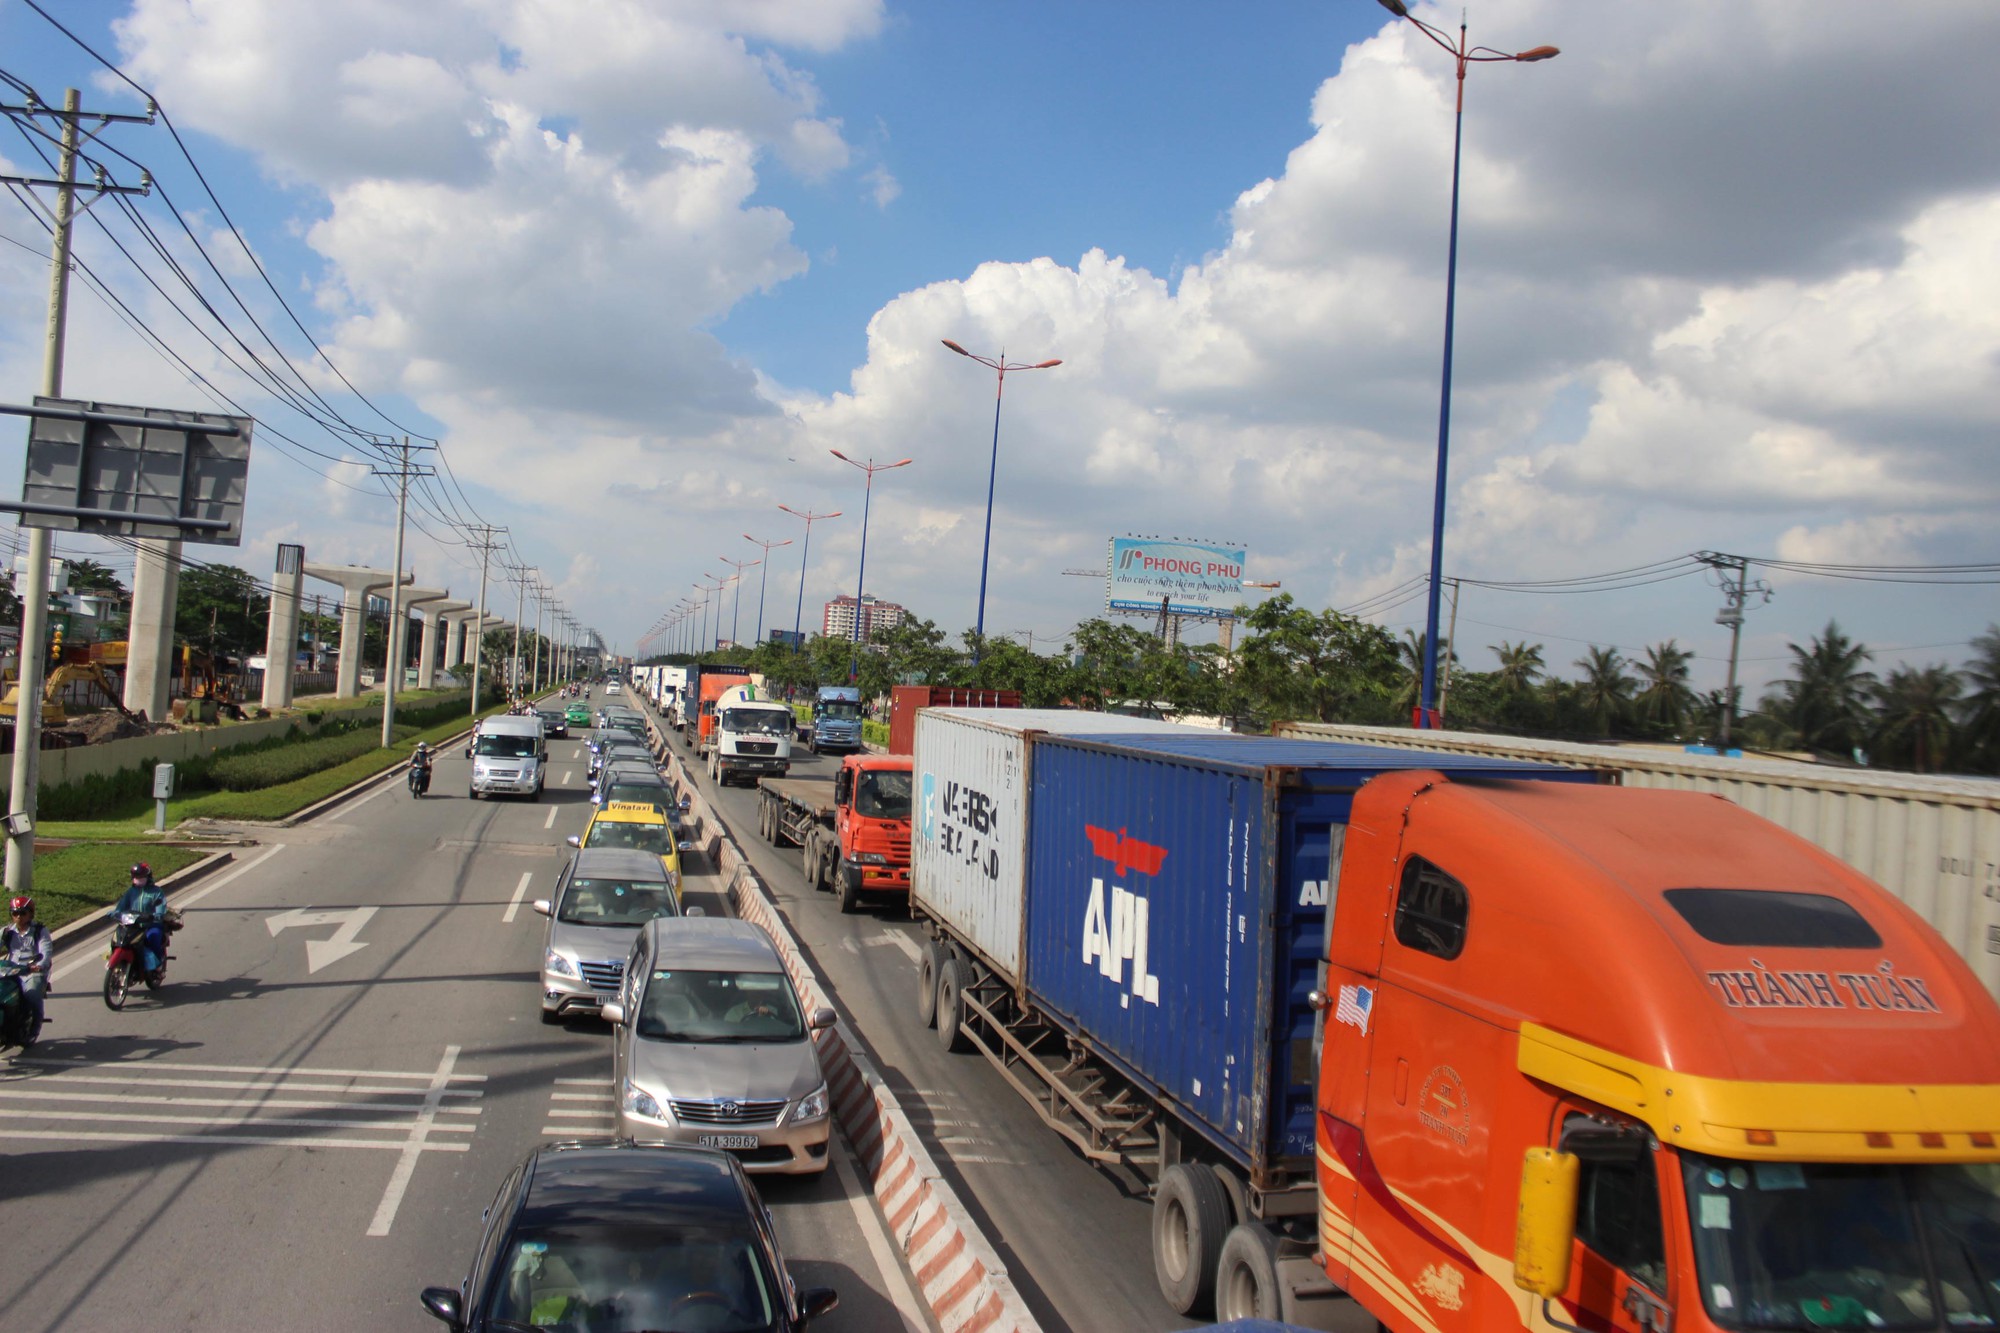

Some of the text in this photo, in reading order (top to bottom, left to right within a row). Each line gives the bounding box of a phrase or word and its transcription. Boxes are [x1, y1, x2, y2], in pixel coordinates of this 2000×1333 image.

[1143, 556, 1241, 579] PHONG PHU
[1117, 574, 1132, 584] cho
[1134, 575, 1153, 586] cuộc
[1175, 578, 1196, 589] thêm
[1197, 580, 1222, 593] phong
[1155, 590, 1179, 599] enrich
[1179, 593, 1196, 602] your
[1197, 592, 1210, 603] life
[611, 803, 651, 811] Vinataxi
[1083, 877, 1159, 1008] APL
[1706, 957, 1846, 1009] THÀNH
